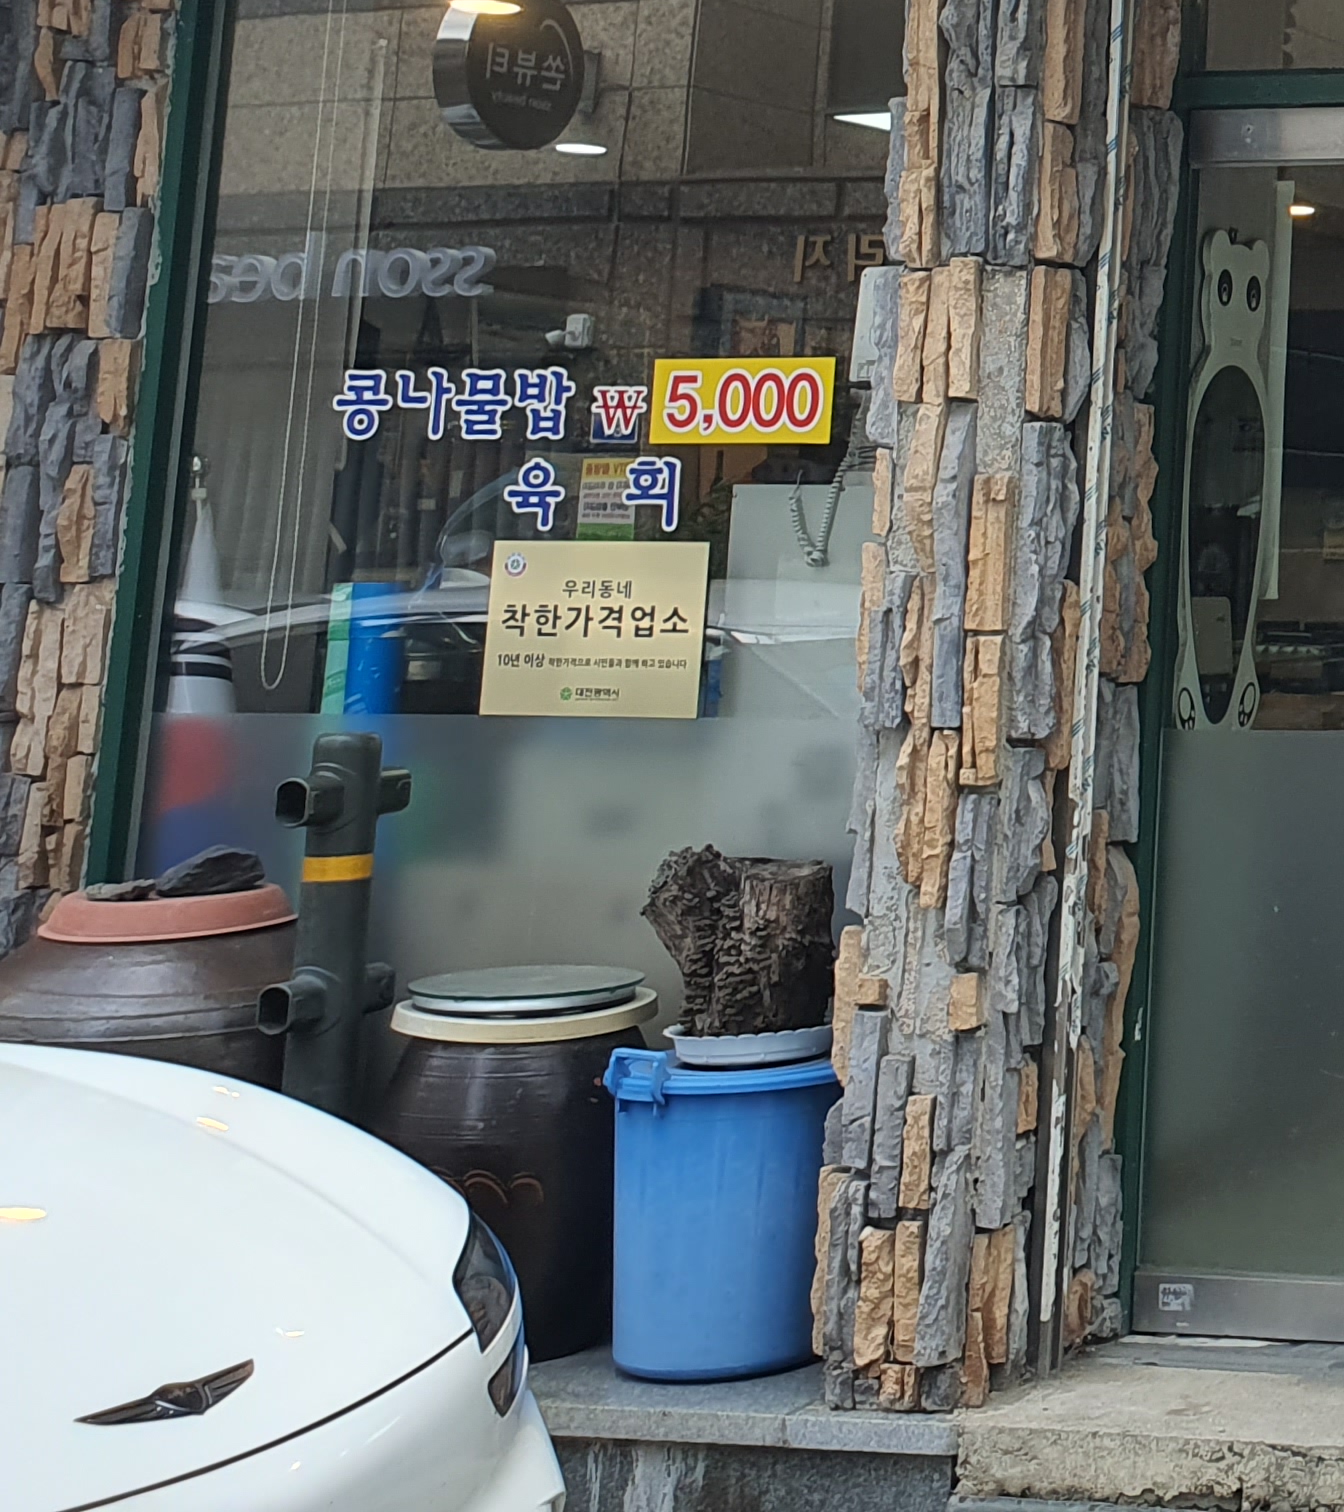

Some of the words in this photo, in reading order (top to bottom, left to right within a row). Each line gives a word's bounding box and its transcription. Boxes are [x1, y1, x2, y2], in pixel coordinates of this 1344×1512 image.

[334, 366, 576, 440] 콩나물밥
[665, 368, 822, 436] 5,000
[562, 580, 632, 599] 우리동네
[501, 604, 689, 638] 착한가격업소
[497, 653, 520, 668] 10년
[524, 653, 545, 668] 이상
